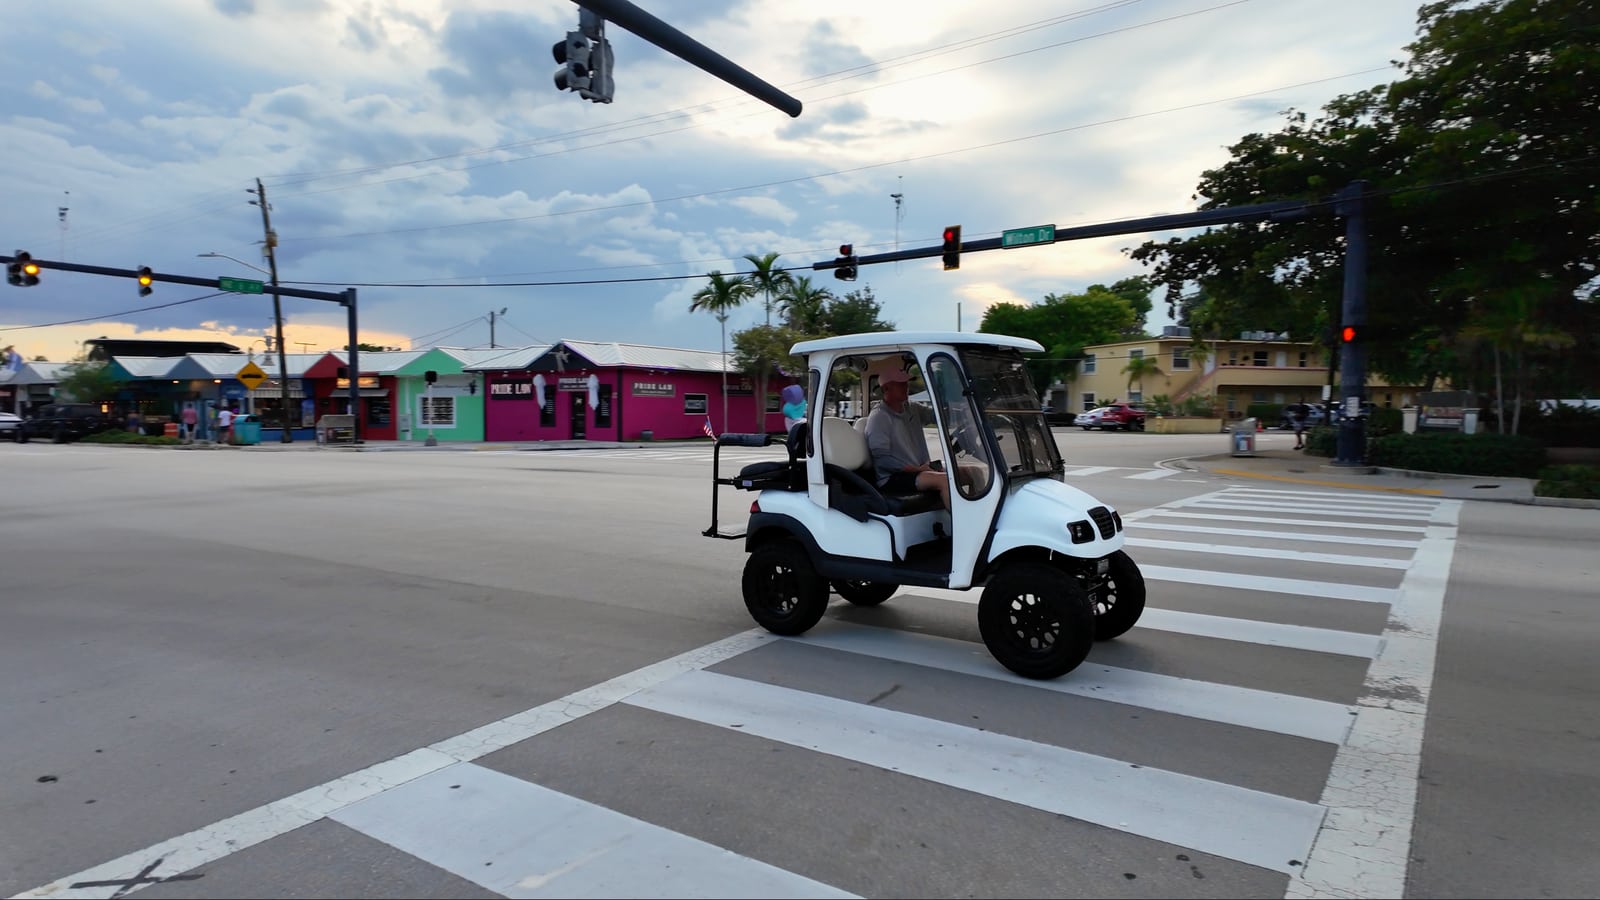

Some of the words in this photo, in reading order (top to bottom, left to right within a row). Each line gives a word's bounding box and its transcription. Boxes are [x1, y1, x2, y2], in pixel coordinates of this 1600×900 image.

[1039, 229, 1050, 241] Dr
[490, 383, 513, 394] PRIDE
[515, 383, 532, 394] LAW
[634, 382, 656, 390] PRIDE
